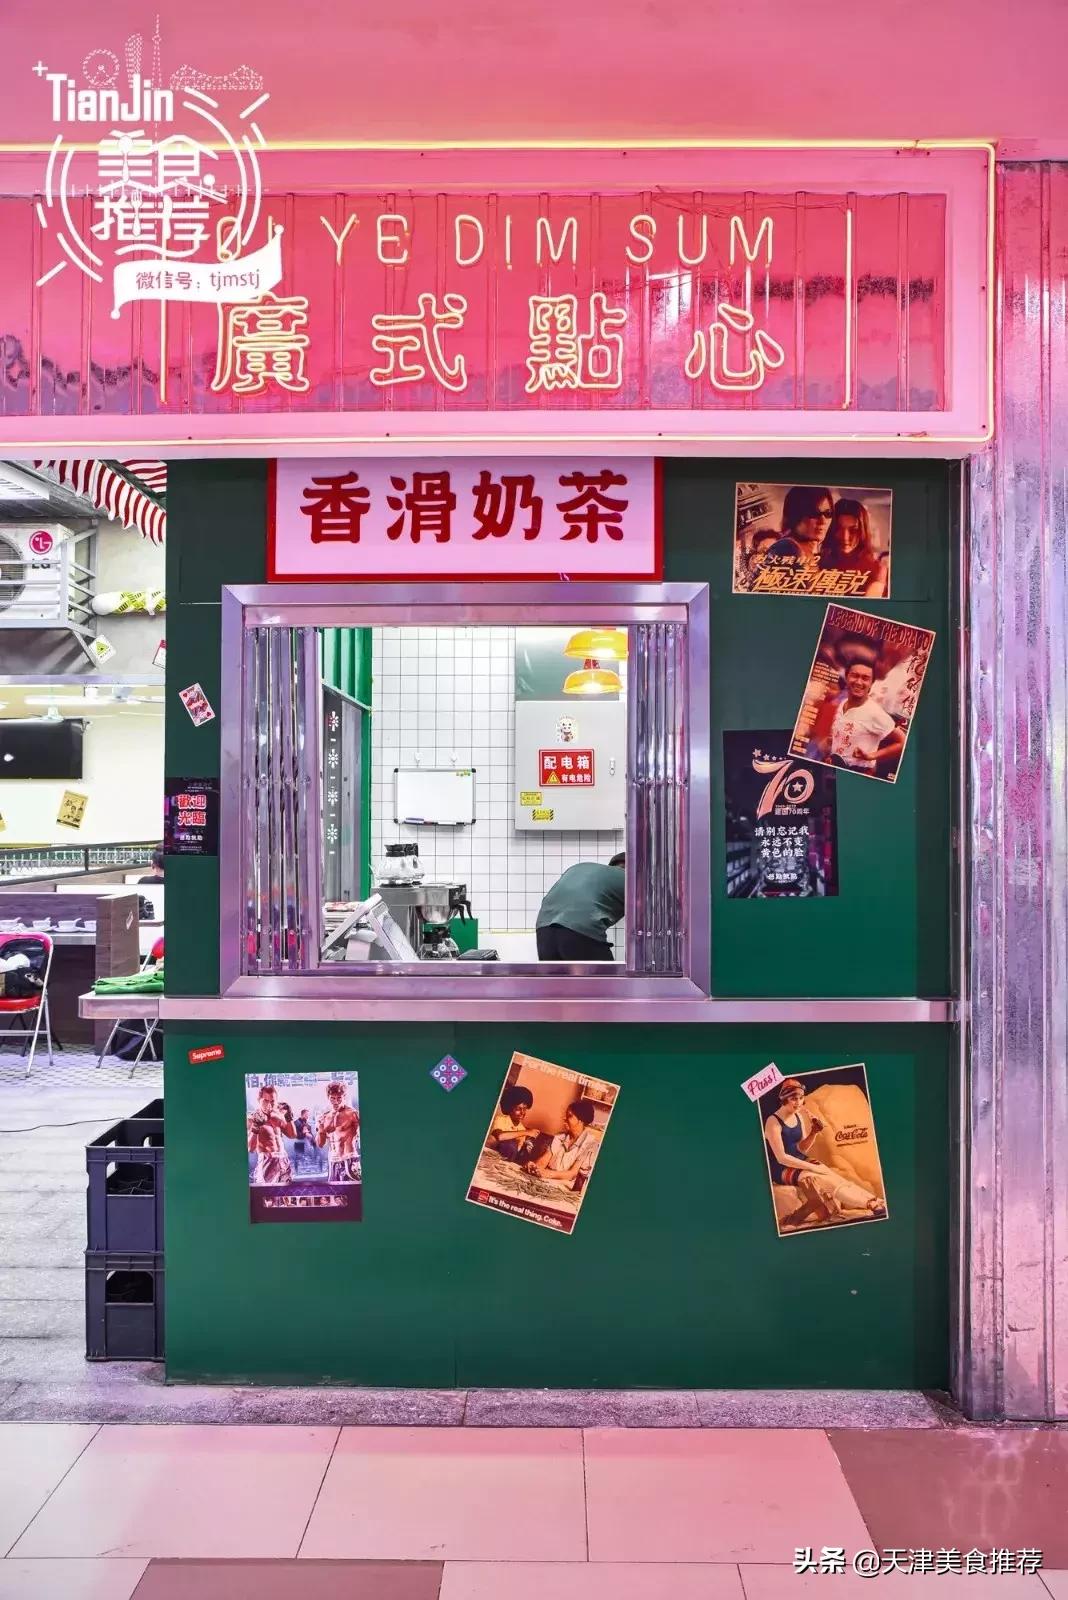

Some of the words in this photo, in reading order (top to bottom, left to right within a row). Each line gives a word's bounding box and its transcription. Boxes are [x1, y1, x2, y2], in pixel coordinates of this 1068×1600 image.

[320, 213, 408, 266] YE
[455, 214, 577, 268] DIM
[625, 214, 774, 266] SUM
[300, 470, 629, 544] 香滑奶茶
[543, 755, 590, 770] 配电箱
[747, 1067, 777, 1096] Pass!
